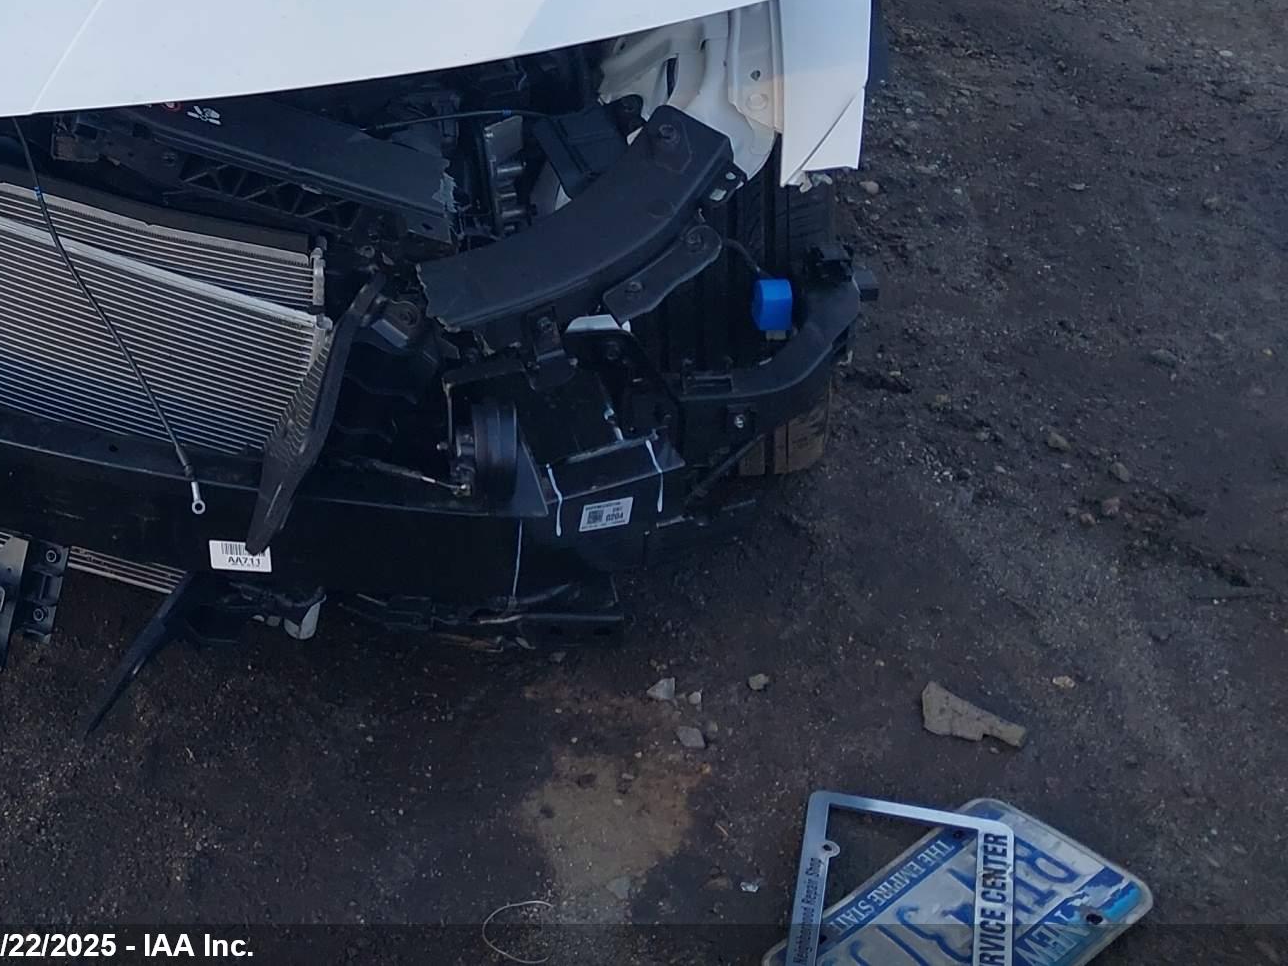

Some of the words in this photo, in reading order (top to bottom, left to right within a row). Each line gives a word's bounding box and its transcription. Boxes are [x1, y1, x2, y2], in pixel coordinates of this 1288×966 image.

[917, 840, 955, 867] THE
[983, 833, 1009, 902] CENTER
[867, 861, 927, 906] EMPIRE
[978, 905, 1007, 965] RVICE
